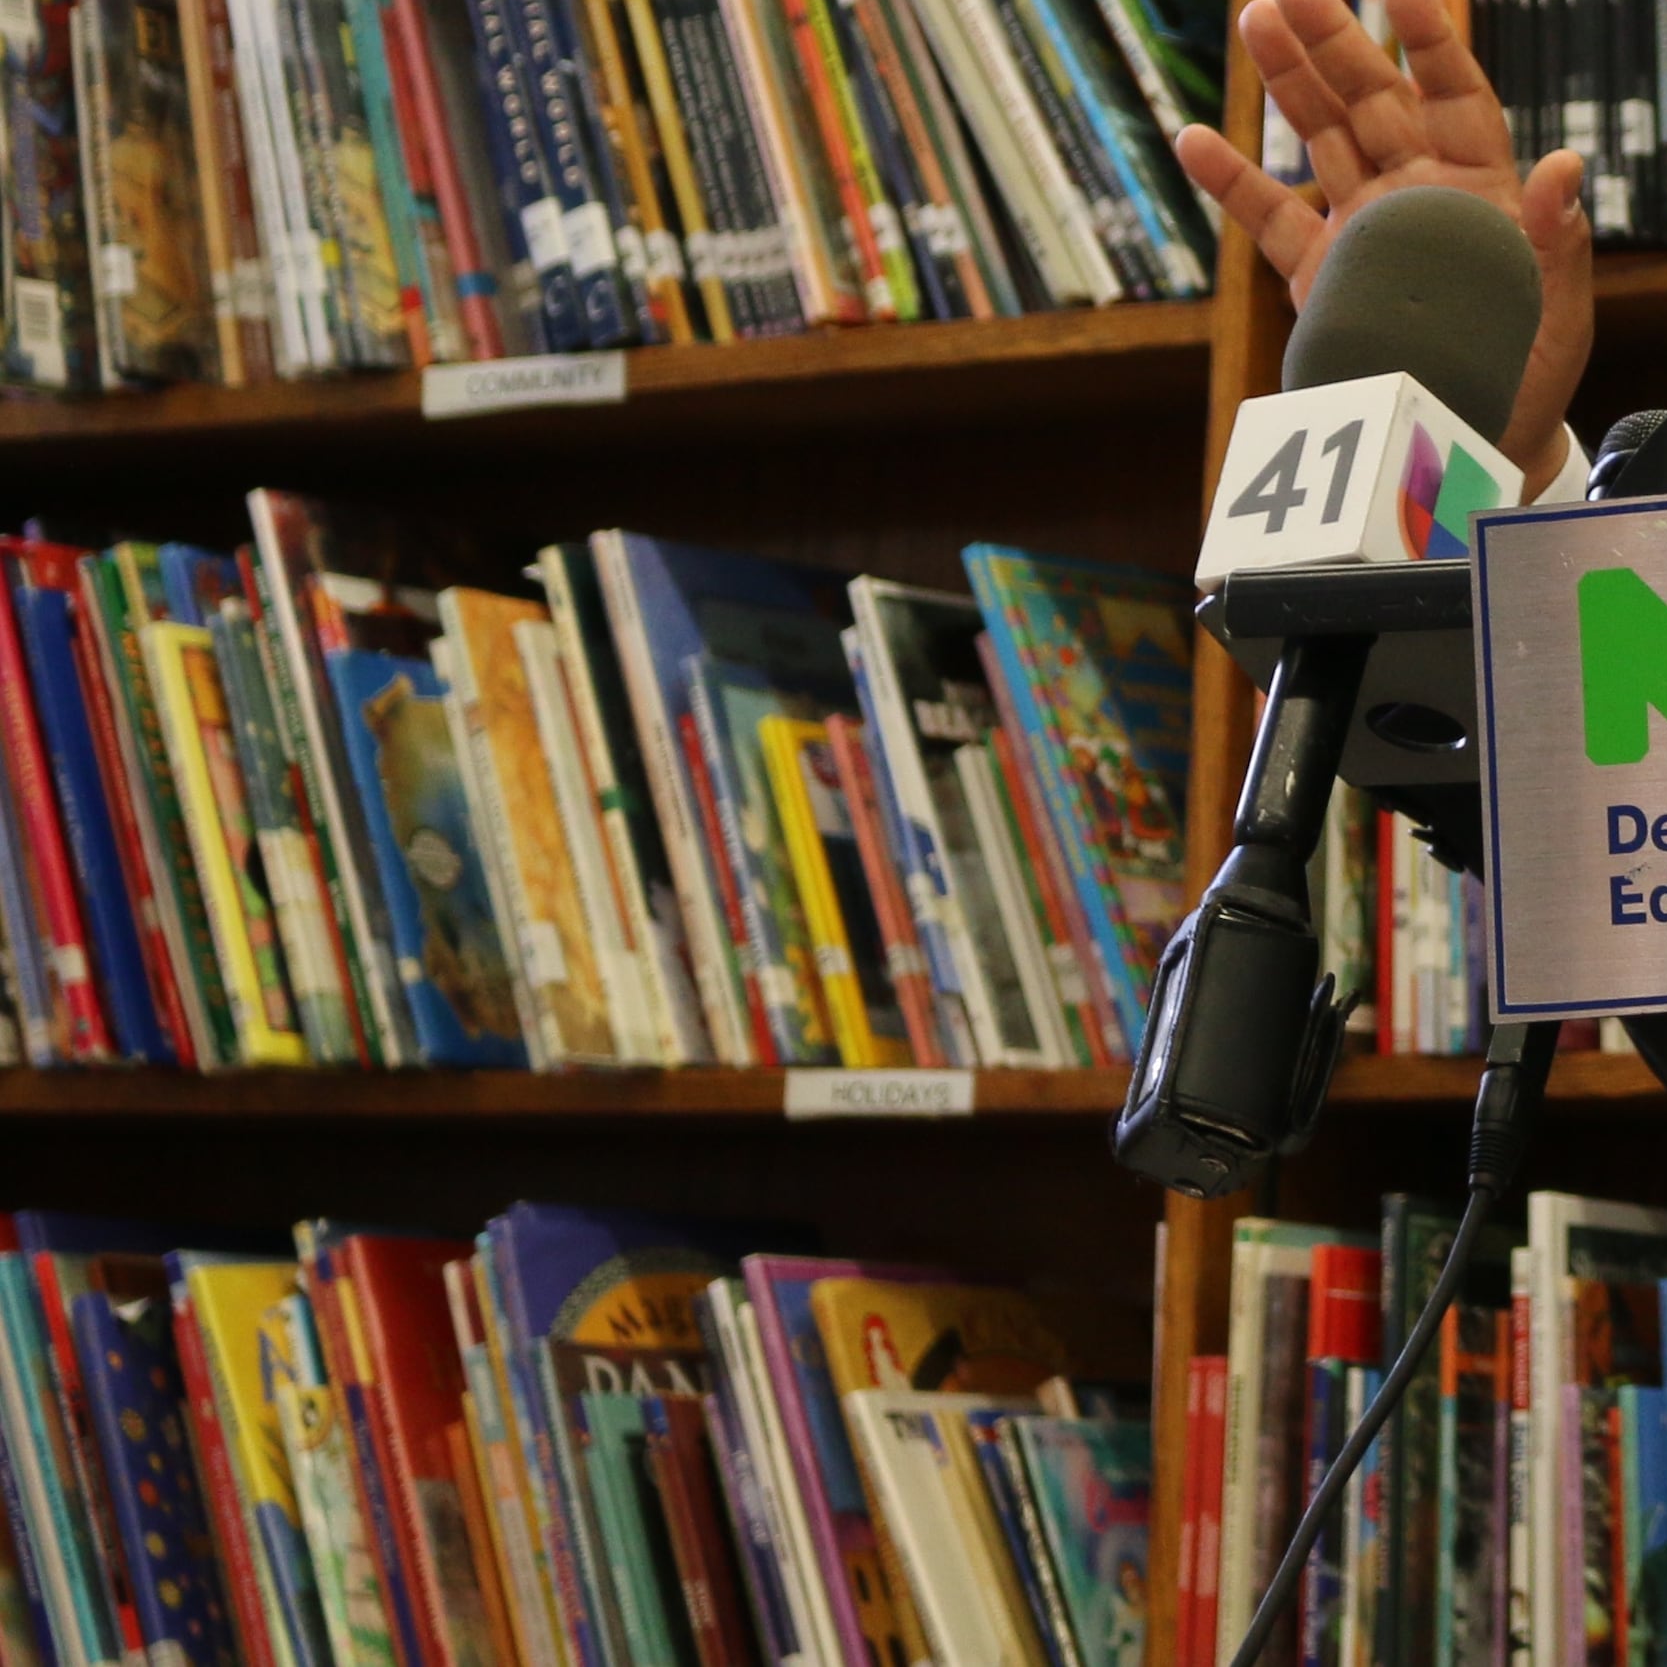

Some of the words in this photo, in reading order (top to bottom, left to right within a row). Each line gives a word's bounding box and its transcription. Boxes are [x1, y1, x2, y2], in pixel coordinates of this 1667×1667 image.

[491, 64, 543, 186] WORLD
[535, 67, 590, 190] WORLD
[465, 357, 605, 397] COMMUNITY
[1228, 420, 1365, 534] 41
[831, 1080, 951, 1111] HOLIDAYS
